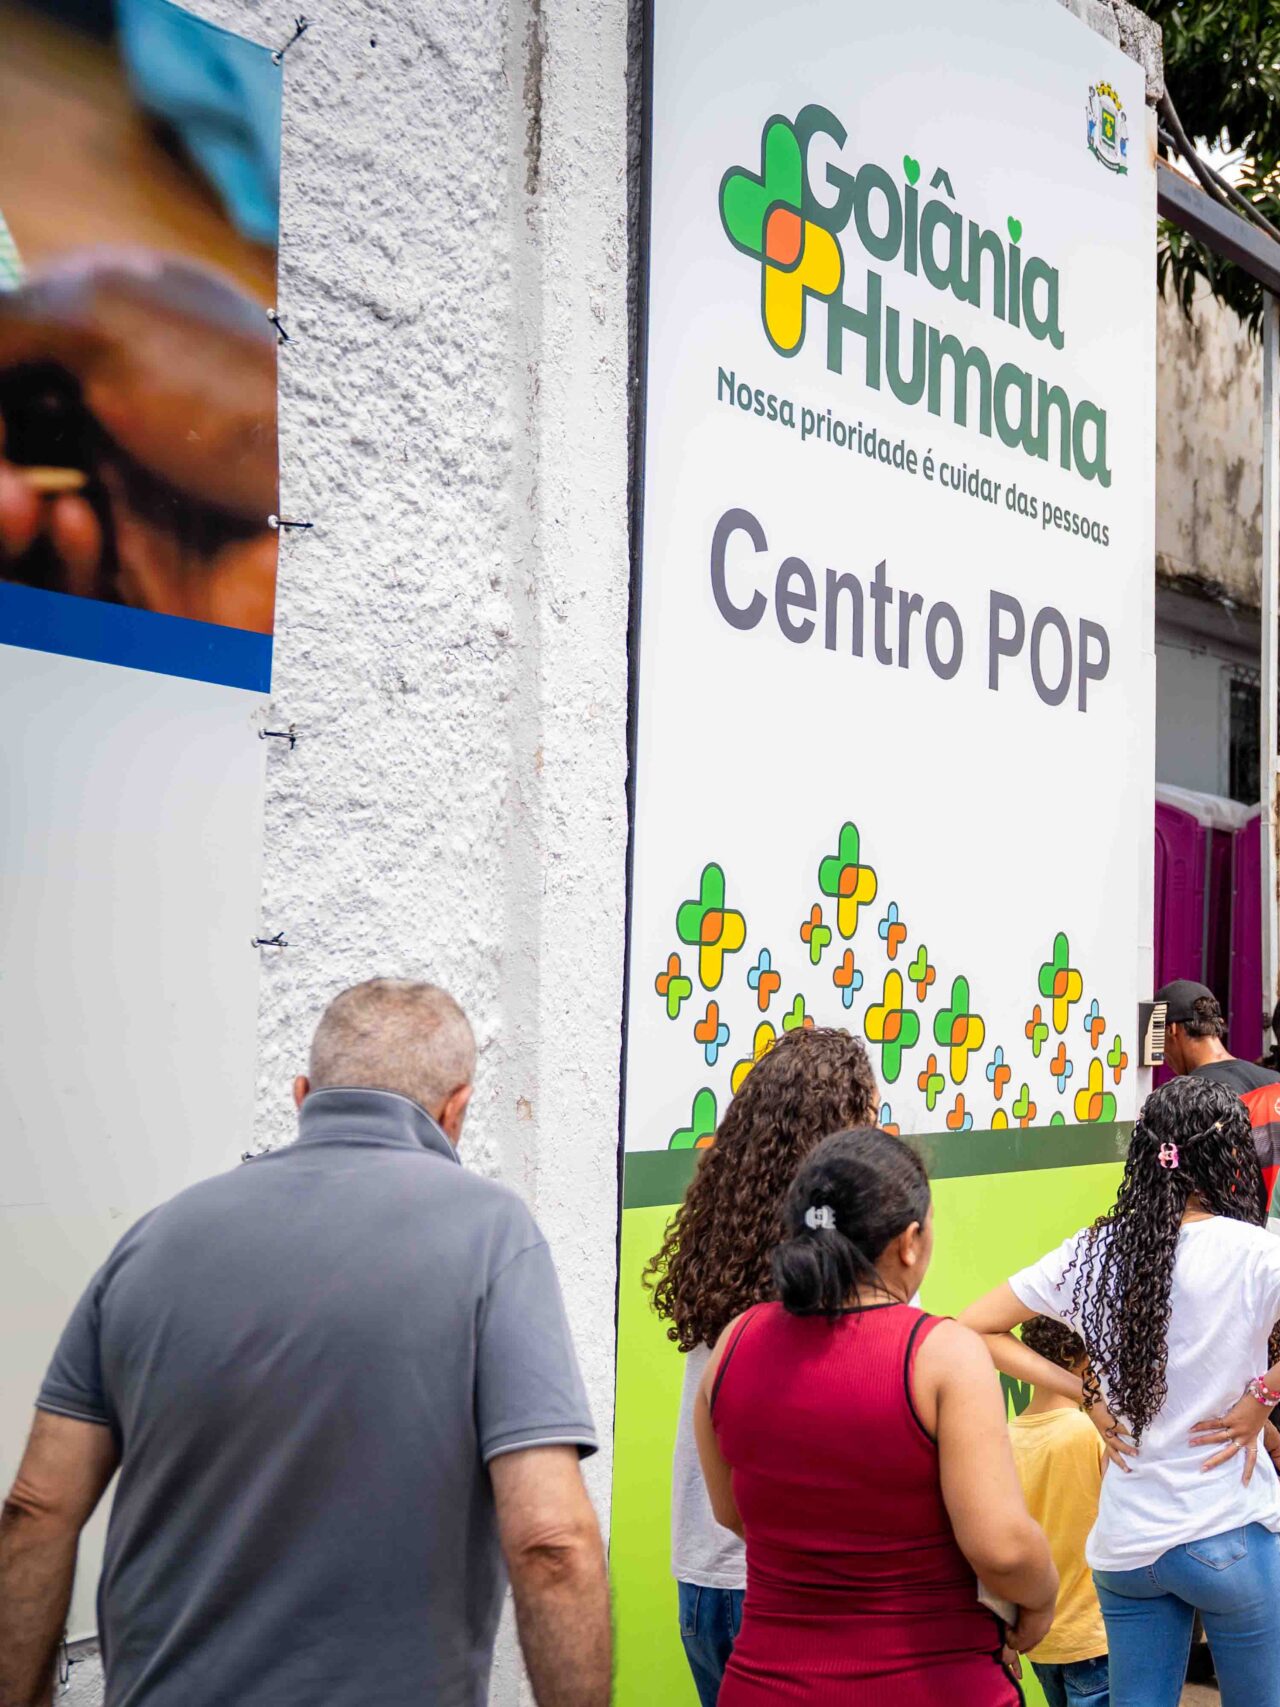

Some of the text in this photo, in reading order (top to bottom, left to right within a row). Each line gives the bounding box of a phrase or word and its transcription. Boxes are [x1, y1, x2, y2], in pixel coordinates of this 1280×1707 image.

[794, 104, 1065, 350] Goiânia
[718, 366, 1110, 546] Nossa prioridade é cuidar das pessoas
[826, 269, 1112, 488] Humana
[710, 507, 1111, 713] Centro POP
